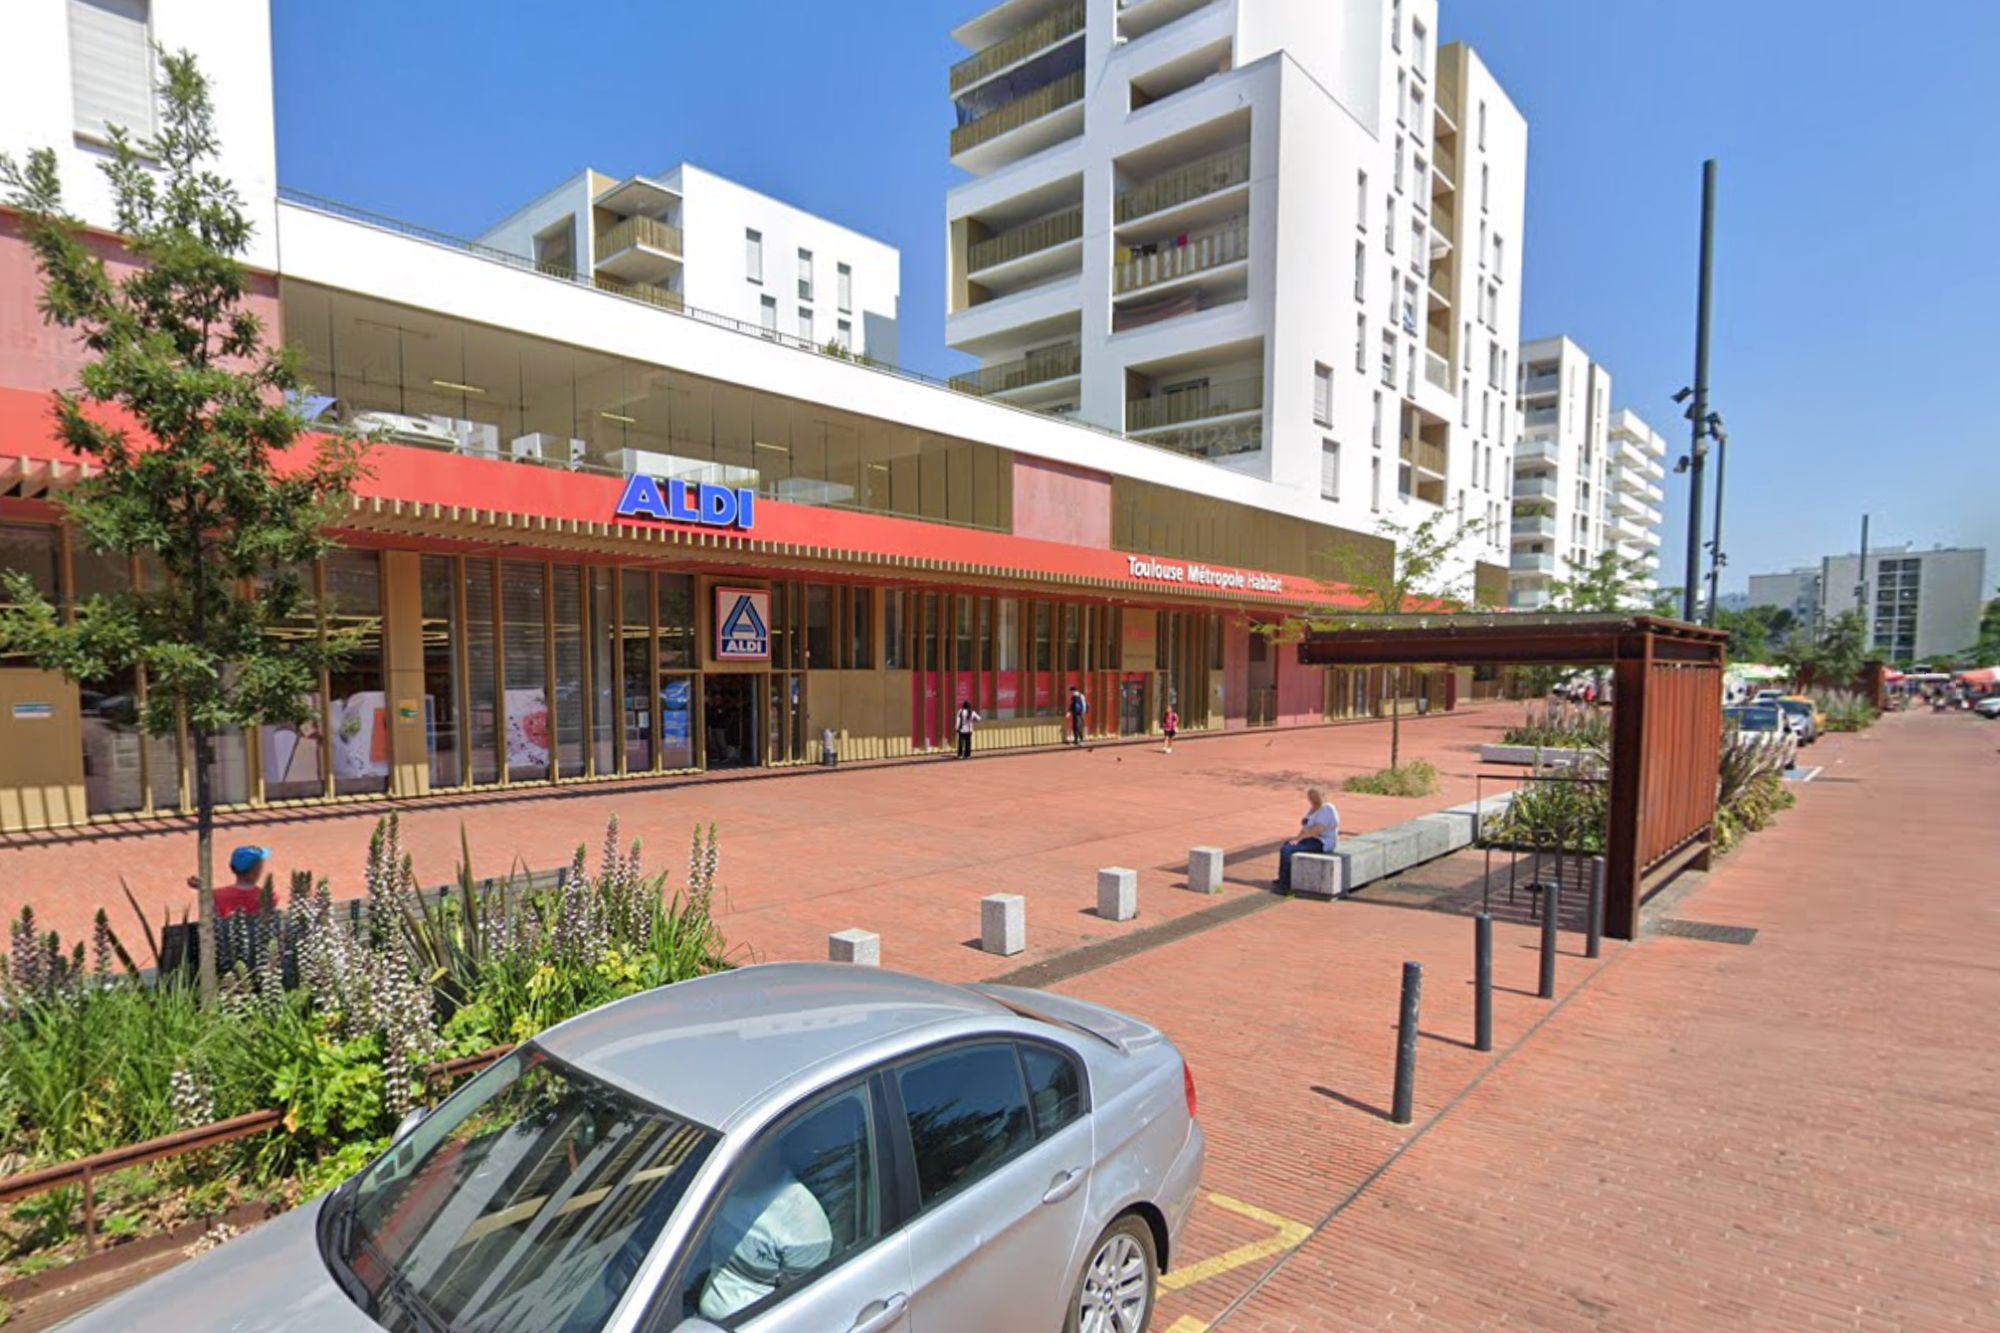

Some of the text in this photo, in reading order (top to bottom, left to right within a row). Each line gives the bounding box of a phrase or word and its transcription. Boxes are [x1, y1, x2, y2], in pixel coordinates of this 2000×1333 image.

[616, 473, 755, 529] ALDI
[1128, 555, 1282, 592] Toulouse Métropole Habitat
[726, 640, 762, 653] ALDI
